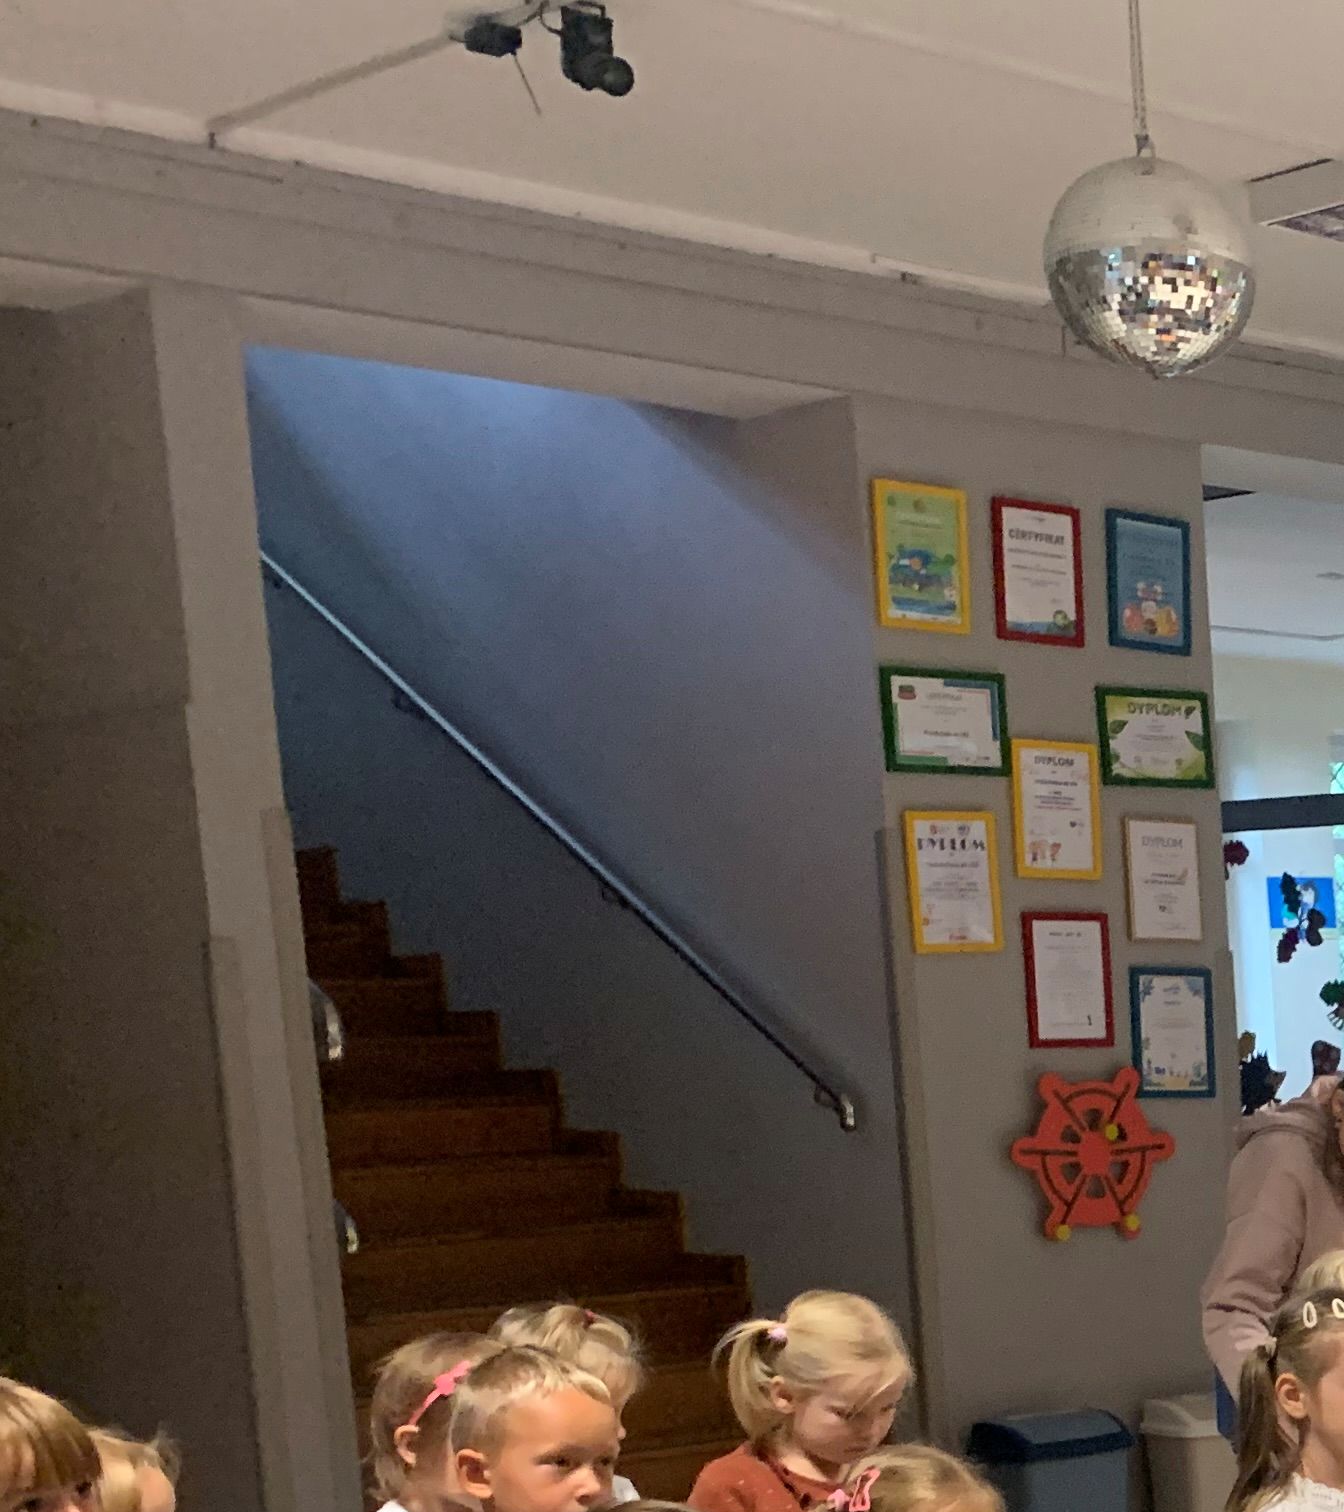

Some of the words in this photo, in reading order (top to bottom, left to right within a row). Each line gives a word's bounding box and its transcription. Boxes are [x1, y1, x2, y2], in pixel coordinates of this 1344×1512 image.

[1127, 702, 1183, 717] DYPLOM
[1034, 755, 1075, 767] DYPLOM
[917, 837, 985, 851] DYPLOM
[1141, 835, 1184, 849] DYPLOM
